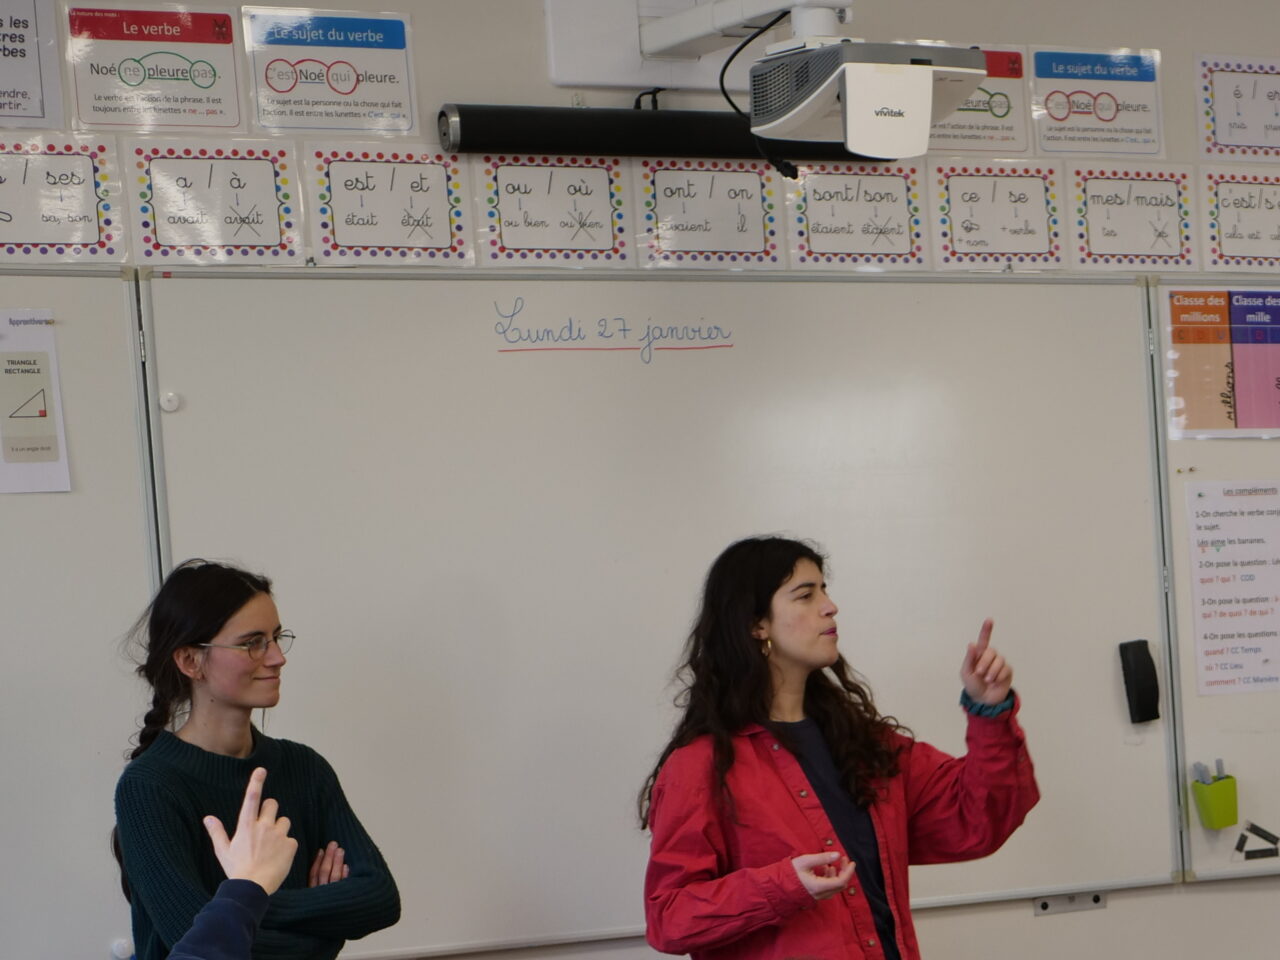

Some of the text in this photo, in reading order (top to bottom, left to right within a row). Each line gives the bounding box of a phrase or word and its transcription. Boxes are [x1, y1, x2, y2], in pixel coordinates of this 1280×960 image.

[10, 16, 29, 29] les
[123, 22, 181, 36] Le verbe
[274, 27, 384, 42] Le sujet du verbe
[90, 63, 117, 76] Noé
[124, 66, 140, 77] ne
[148, 65, 189, 80] pleure
[1052, 62, 1138, 76] Le sujet du verbe
[300, 69, 324, 82] Noé
[331, 70, 350, 86] qui
[357, 70, 400, 87] pleure.
[874, 107, 905, 118] vivitek
[1072, 100, 1092, 110] Noé
[1116, 101, 1150, 115] pleure.
[46, 170, 85, 185] ses
[176, 172, 246, 189] a à
[344, 171, 430, 192] est et
[505, 179, 593, 196] ou où
[664, 180, 753, 200] ont on
[961, 190, 1028, 203] ce se
[68, 214, 92, 222] son
[167, 211, 208, 224] avait
[345, 212, 378, 226] était
[504, 218, 518, 228] ou
[523, 211, 549, 228] bien
[736, 214, 748, 233] il
[810, 222, 854, 234] étaient
[1174, 295, 1225, 306] Classe des
[1232, 295, 1264, 306] Classe
[1180, 311, 1220, 322] millions
[1246, 312, 1271, 322] mille
[494, 297, 732, 364] Lundi 27 janvier
